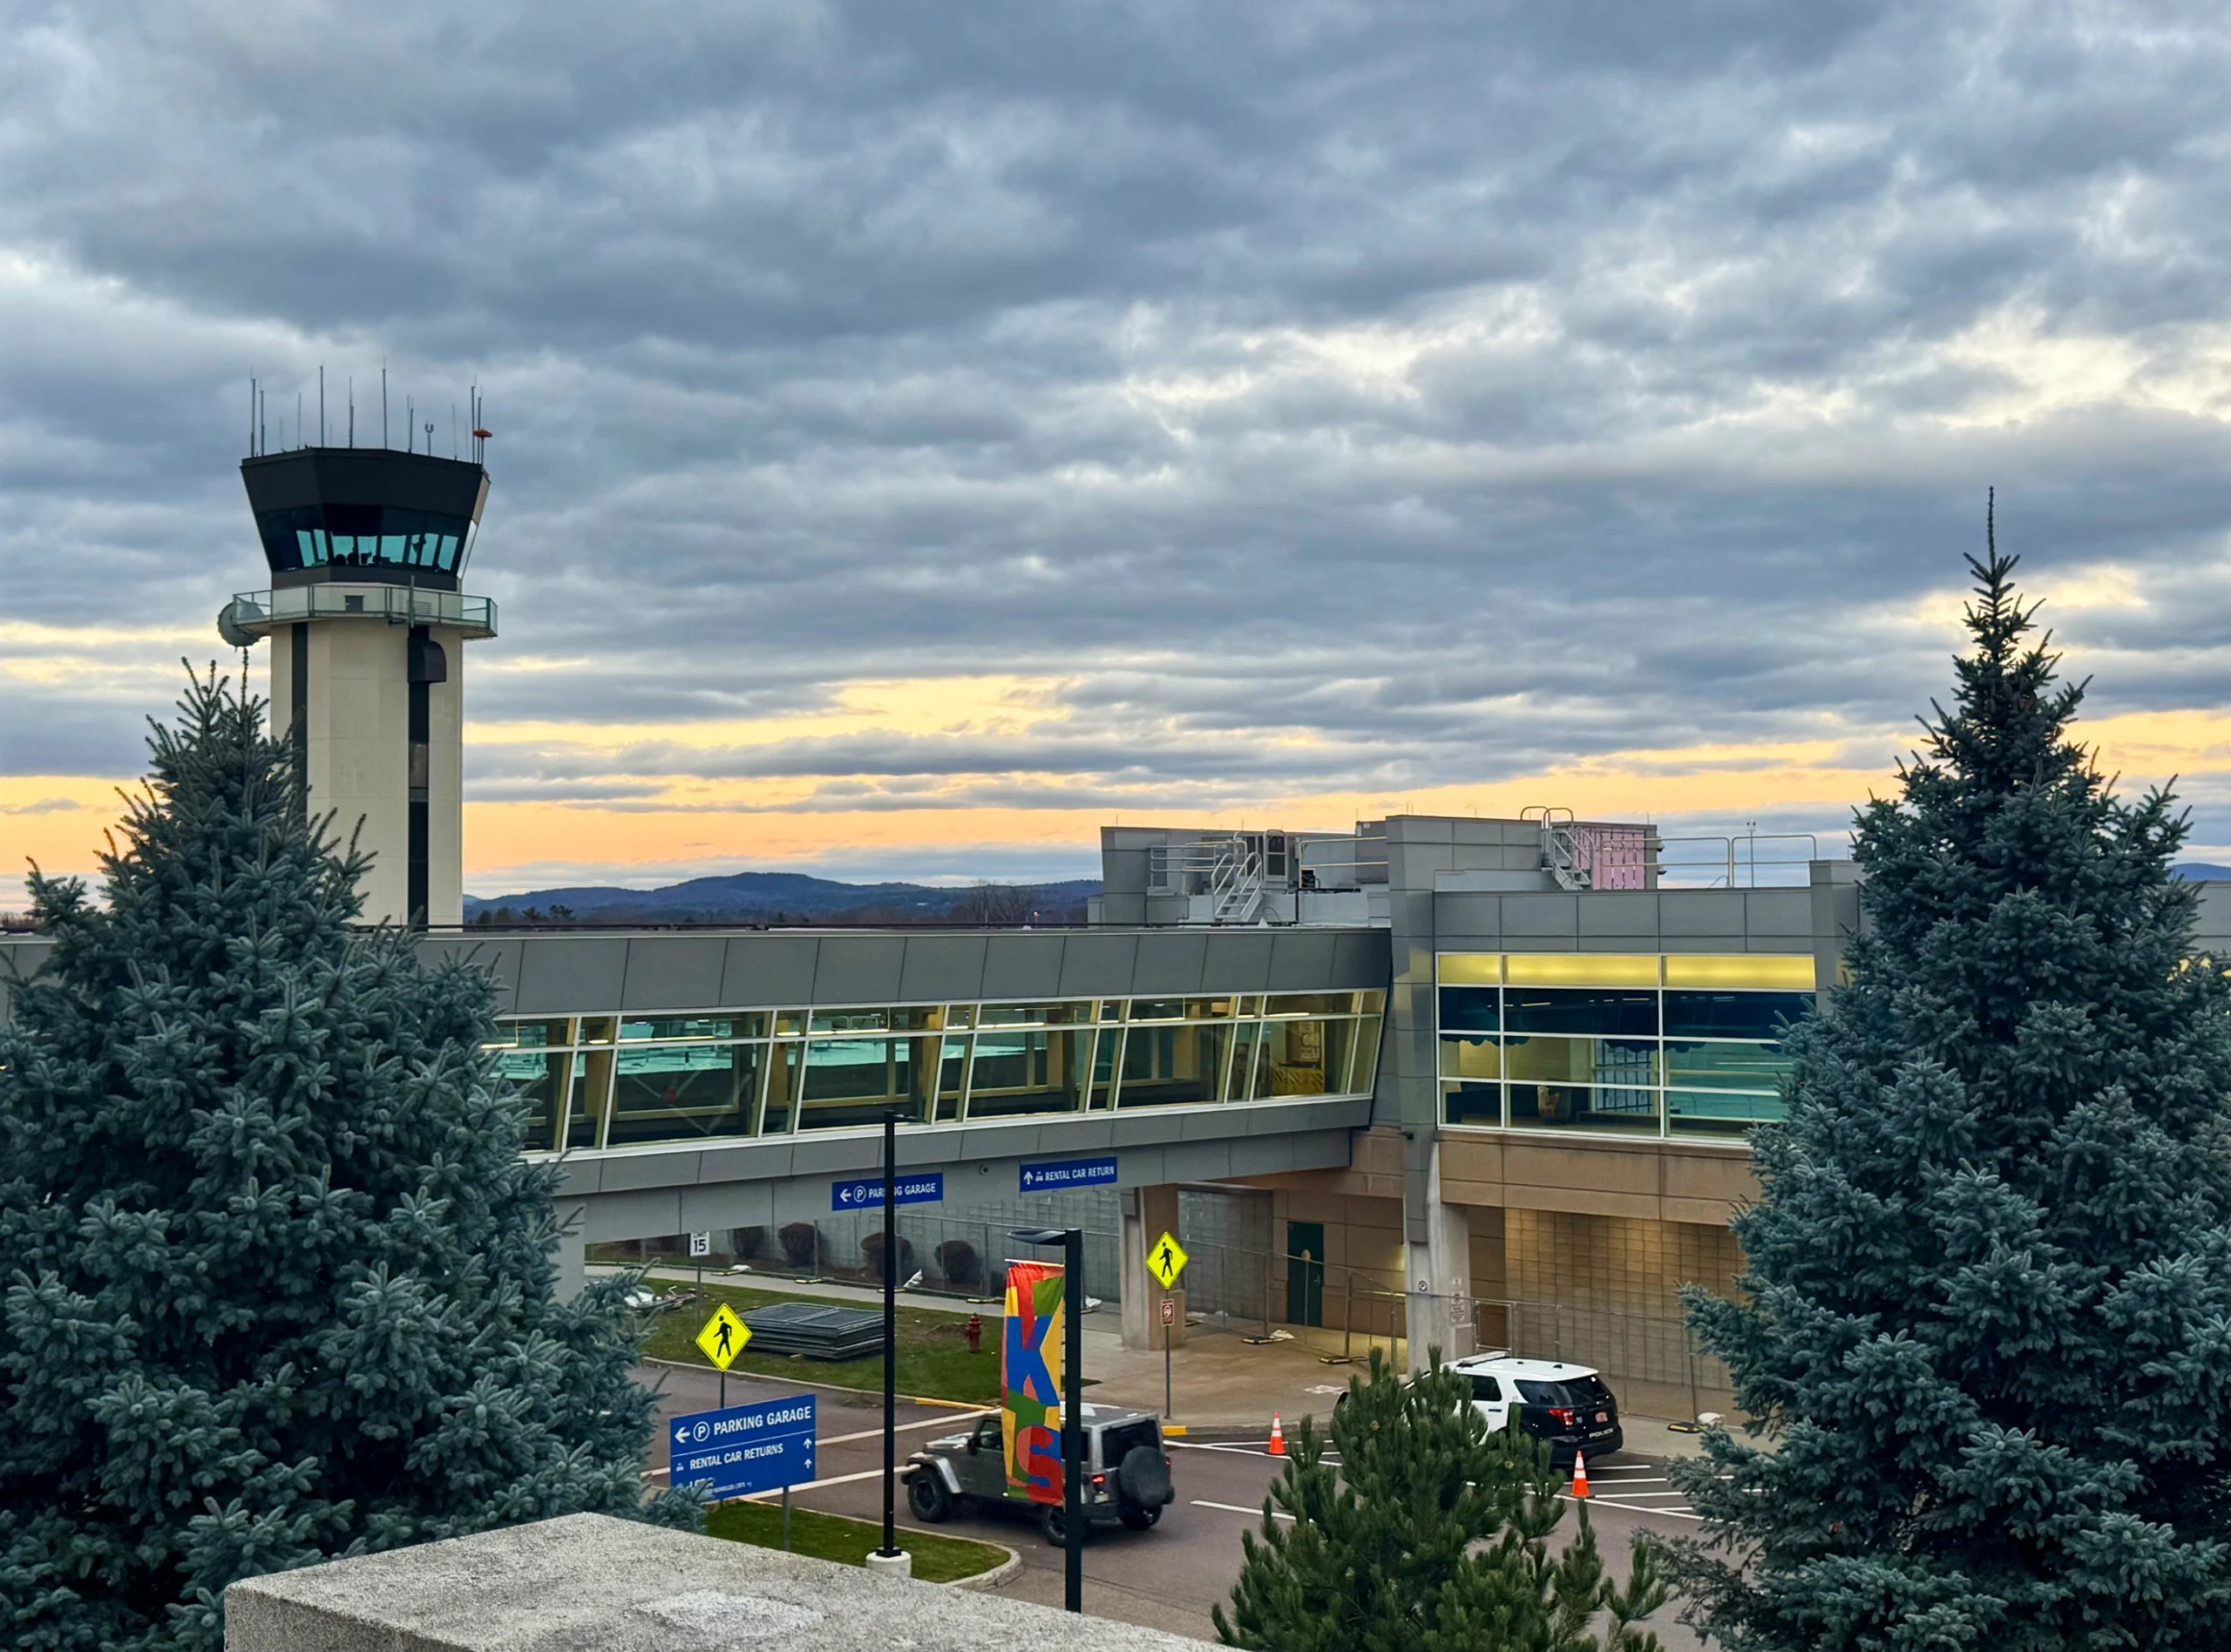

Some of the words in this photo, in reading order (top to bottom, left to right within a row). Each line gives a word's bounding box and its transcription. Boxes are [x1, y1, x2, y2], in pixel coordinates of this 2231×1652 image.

[1045, 1170, 1070, 1181] RENTAL
[1072, 1168, 1087, 1179] CAR
[1088, 1166, 1115, 1177] RETURN
[868, 1186, 903, 1199] PARNG
[905, 1182, 936, 1195] GARAGE
[694, 1238, 706, 1252] 15
[714, 1414, 763, 1436] PARKING
[767, 1405, 811, 1425] GARAGE
[1589, 1427, 1614, 1439] POLICE
[689, 1454, 722, 1471] RENTAL
[723, 1449, 742, 1464] CAR
[743, 1443, 783, 1460] RETURNS
